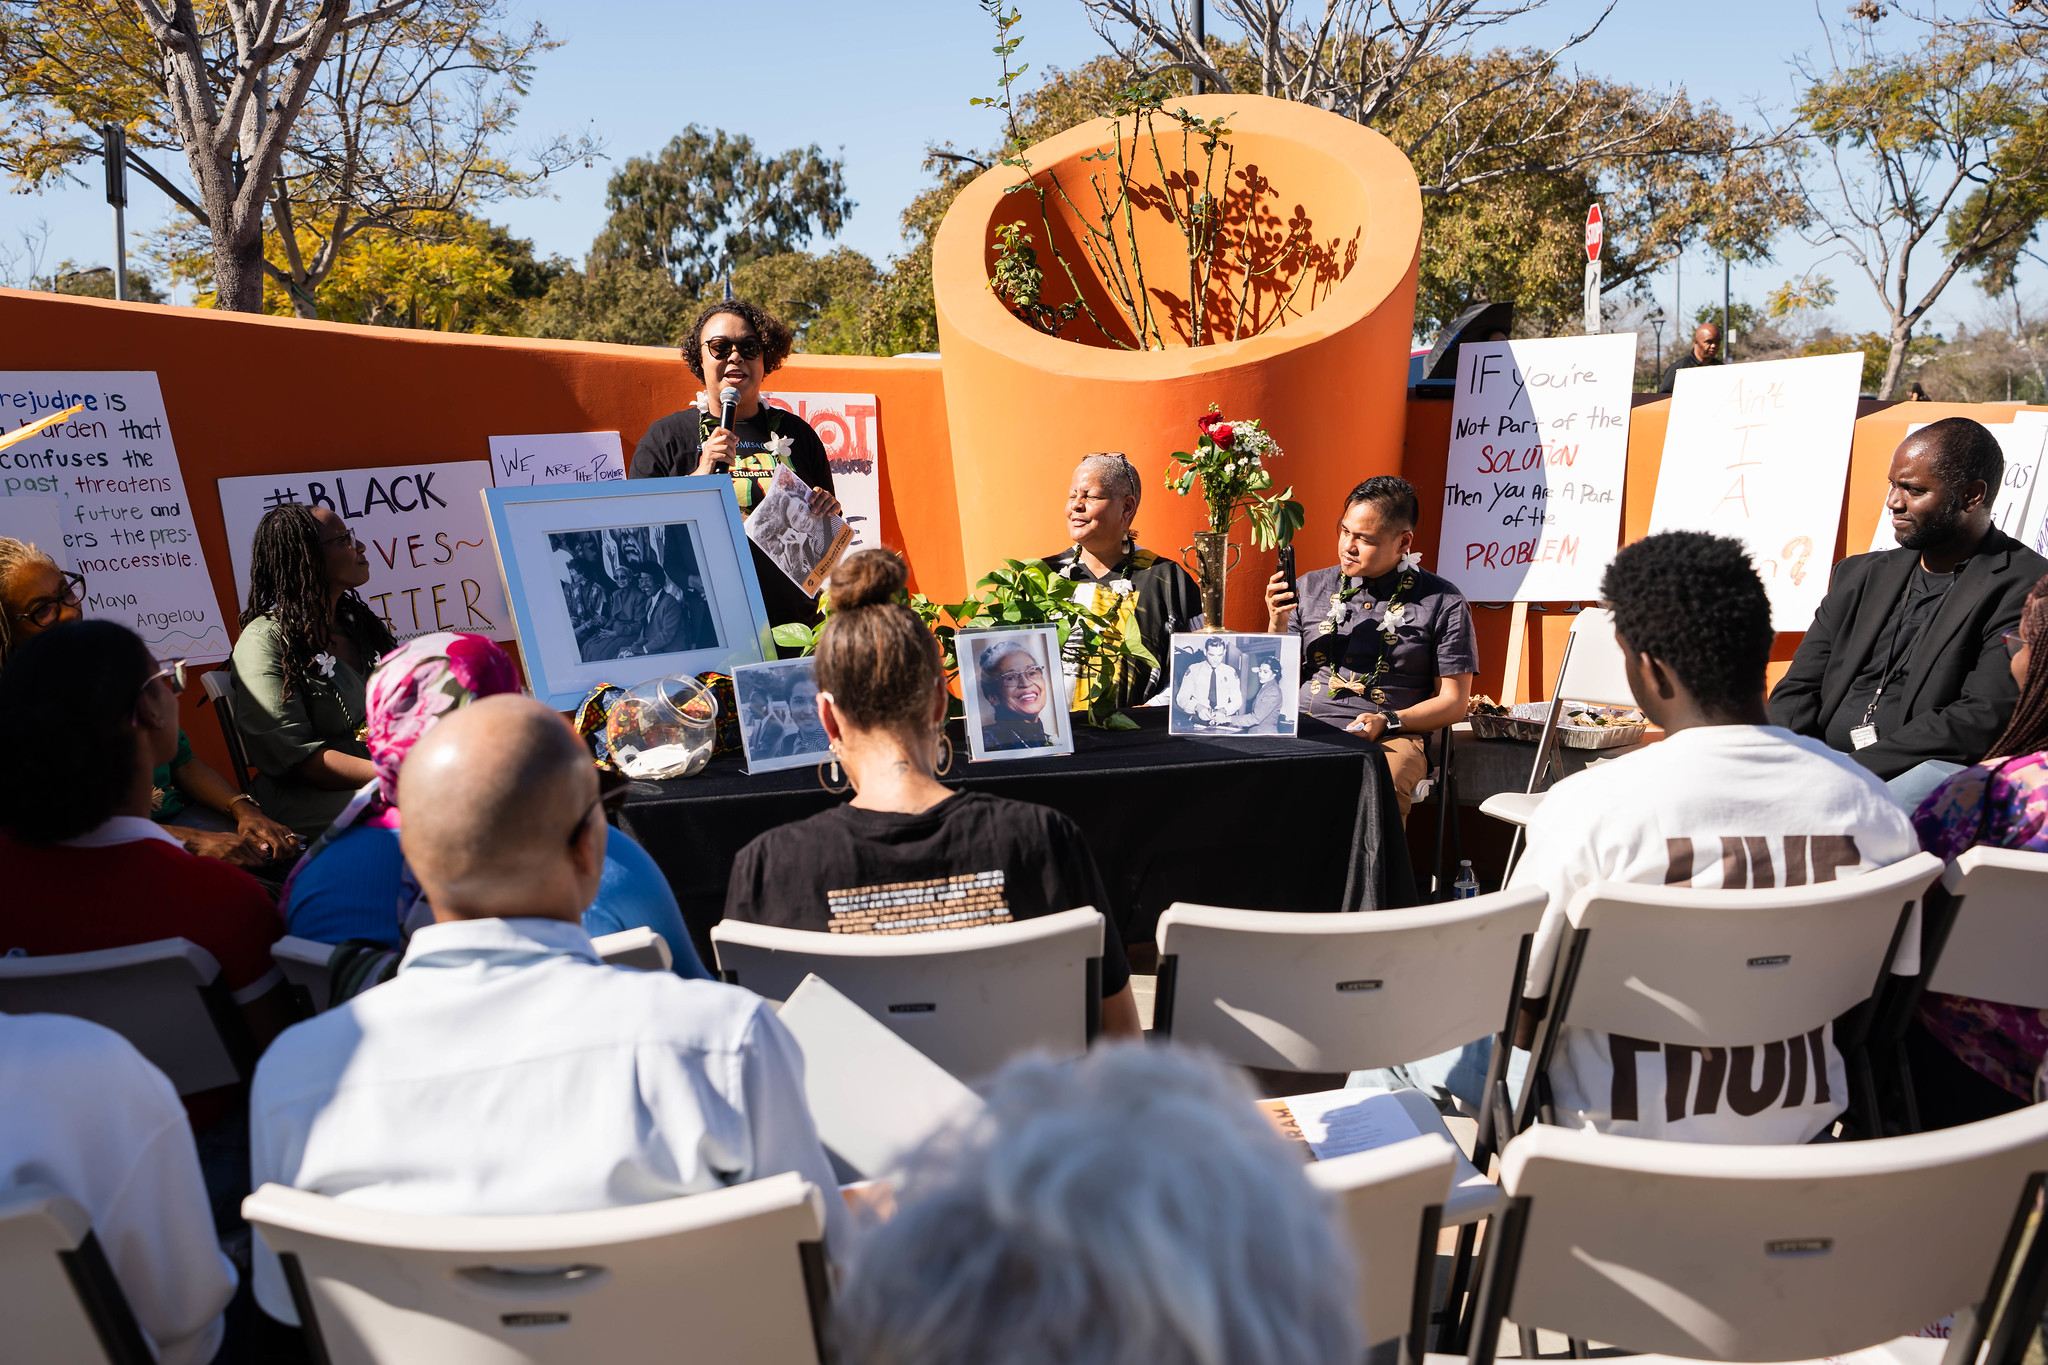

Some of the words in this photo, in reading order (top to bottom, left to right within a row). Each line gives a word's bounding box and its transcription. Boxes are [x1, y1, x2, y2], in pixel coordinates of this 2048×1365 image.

[1587, 221, 1601, 246] STOP
[1470, 354, 1503, 394] IF
[0, 390, 98, 415] rejudice
[103, 392, 127, 412] is
[118, 417, 162, 440] that
[1455, 416, 1491, 440] Not
[1497, 415, 1545, 436] Part
[1551, 412, 1578, 430] of
[1586, 405, 1624, 430] the
[1723, 424, 1769, 470] I
[0, 449, 109, 470] confuses
[122, 449, 153, 468] the
[544, 463, 573, 478] ARE
[572, 465, 594, 482] THE
[74, 475, 172, 494] threatens
[1445, 483, 1483, 506] Then
[1531, 484, 1554, 500] Are
[1562, 482, 1575, 500] A
[1579, 483, 1615, 505] Part
[1710, 473, 1750, 518] A
[74, 504, 143, 524] future
[150, 503, 181, 517] and
[1502, 504, 1528, 527] of
[1528, 506, 1556, 527] the
[110, 528, 145, 546] the
[149, 528, 192, 550] pres-
[76, 552, 199, 575] inaccessible.
[1465, 534, 1580, 571] PROBLEM
[88, 593, 138, 612] Maya
[136, 609, 206, 630] Angelou
